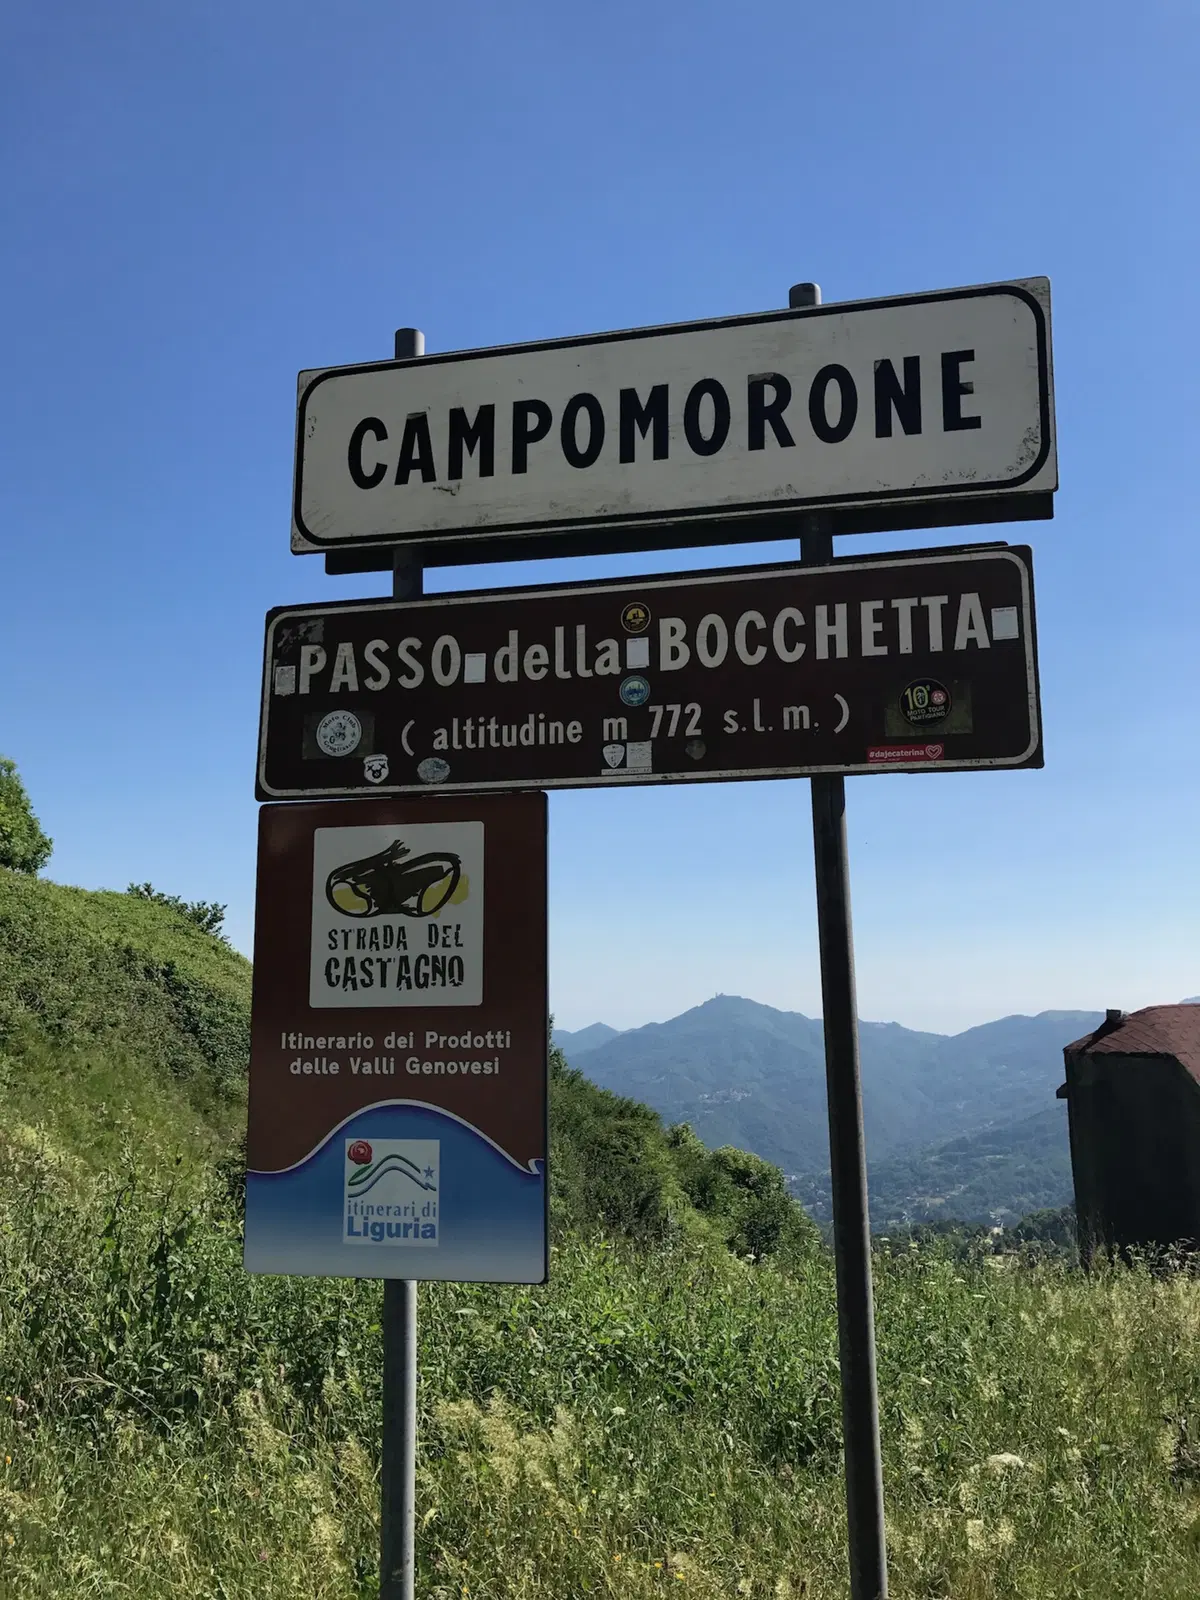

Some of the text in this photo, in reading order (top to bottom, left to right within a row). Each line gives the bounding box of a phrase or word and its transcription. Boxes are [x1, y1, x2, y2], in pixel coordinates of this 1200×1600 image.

[347, 348, 983, 490] CAMPOMORONE
[299, 634, 462, 695] PASSO
[493, 624, 622, 682] della
[658, 592, 991, 672] BOCCHETTA
[322, 714, 356, 728] Moto Club
[907, 705, 945, 717] MOTO TOUR
[432, 712, 583, 750] altitudine
[602, 716, 628, 741] m
[648, 702, 702, 739] 772
[869, 749, 925, 759] #dajecaterina
[328, 923, 464, 951] STRADA DEL
[324, 953, 465, 992] CASTAGNO
[281, 1030, 511, 1050] Itinerario dei Prodotti
[290, 1056, 500, 1075] delle Valli Genovesi
[348, 1200, 437, 1218] itinerari di
[347, 1216, 437, 1242] Liguria
